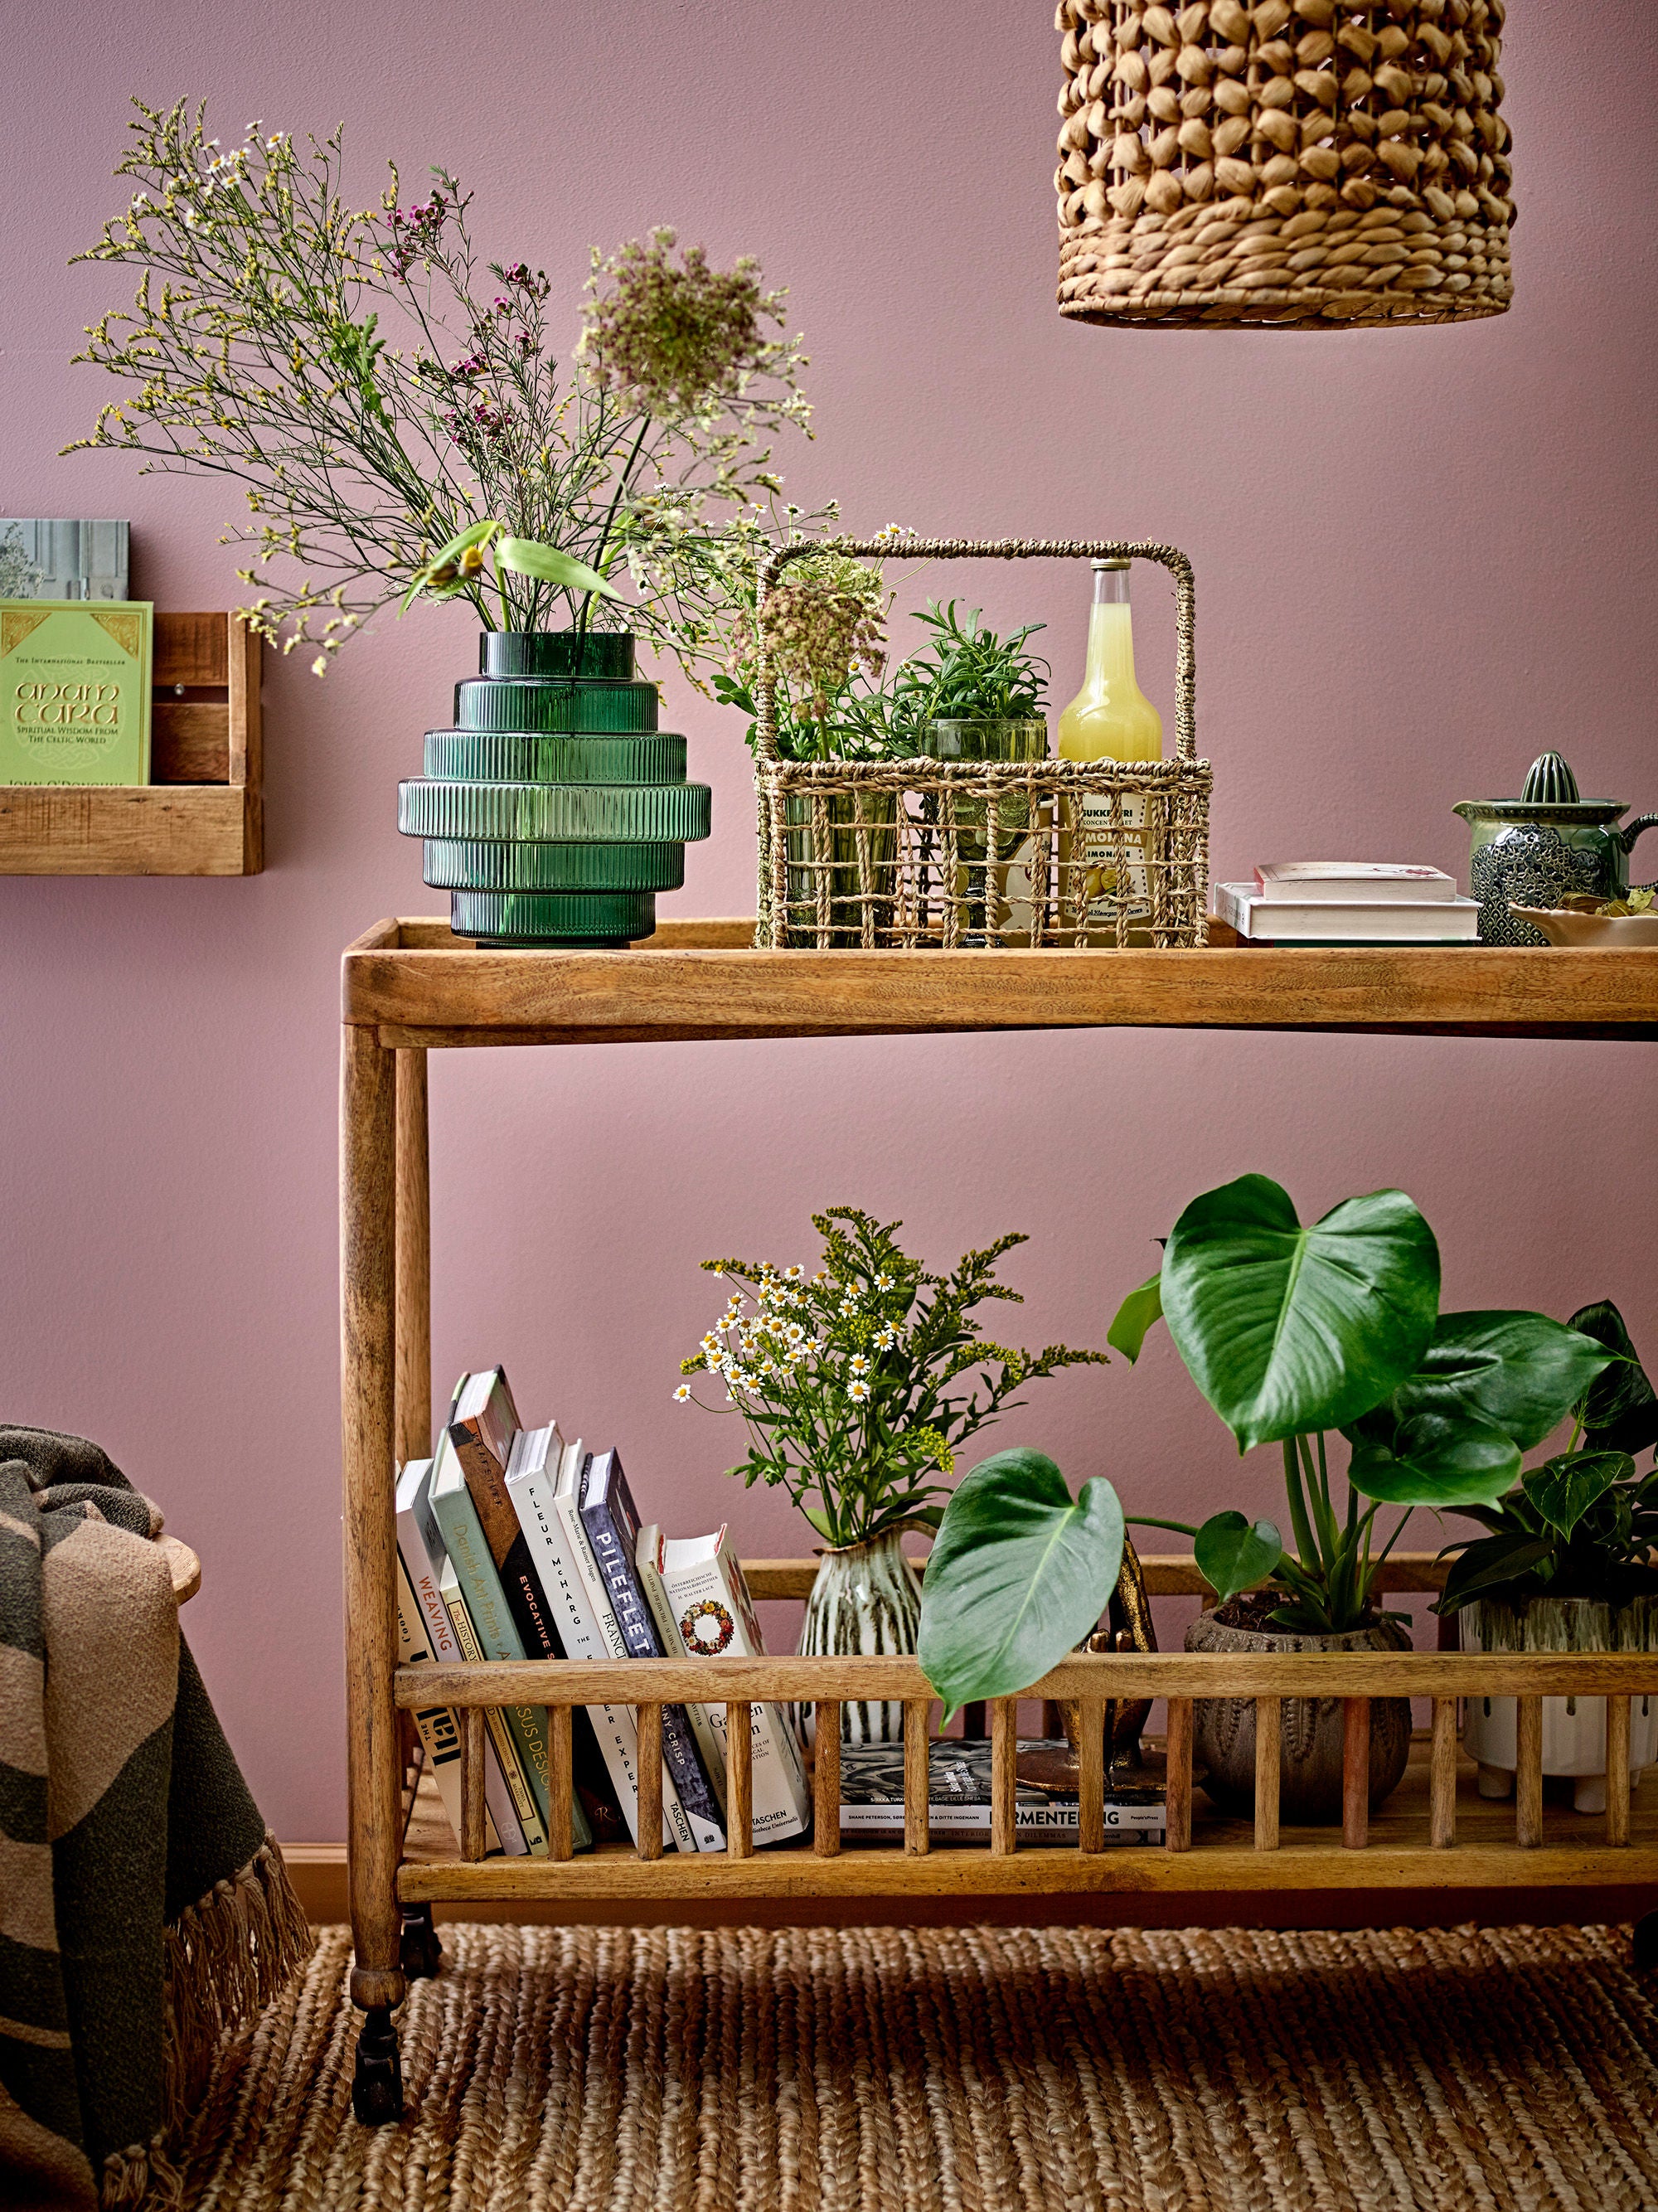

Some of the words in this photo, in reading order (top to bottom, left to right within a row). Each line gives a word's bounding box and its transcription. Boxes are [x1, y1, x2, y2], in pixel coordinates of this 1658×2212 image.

[28, 735, 43, 743] THE
[46, 735, 73, 744] CELTIC
[75, 736, 106, 745] WORLD
[58, 727, 93, 735] WISDOM
[95, 727, 119, 735] FROM
[529, 1487, 554, 1545] FLEUR
[567, 1509, 582, 1540] Rose-Marie
[580, 1545, 590, 1564] Rainer
[587, 1562, 597, 1583] Hagen
[453, 1524, 481, 1575] Danish
[472, 1578, 489, 1601] Art
[481, 1601, 499, 1640] Prints
[596, 1531, 650, 1652] PILEFLET
[419, 1576, 453, 1651] WEAVING
[519, 1575, 551, 1648] EVOCATIVE
[458, 1621, 478, 1661] HISTORY
[577, 1636, 590, 1644] THE
[602, 1612, 627, 1659] FRANCI
[420, 1723, 431, 1741] THE
[668, 1732, 686, 1766] CRISP
[528, 1740, 550, 1792] DESIG
[615, 1735, 638, 1800] EXPER
[670, 1802, 690, 1842] TASCHEN
[1025, 1831, 1067, 1839] DILEMMAS
